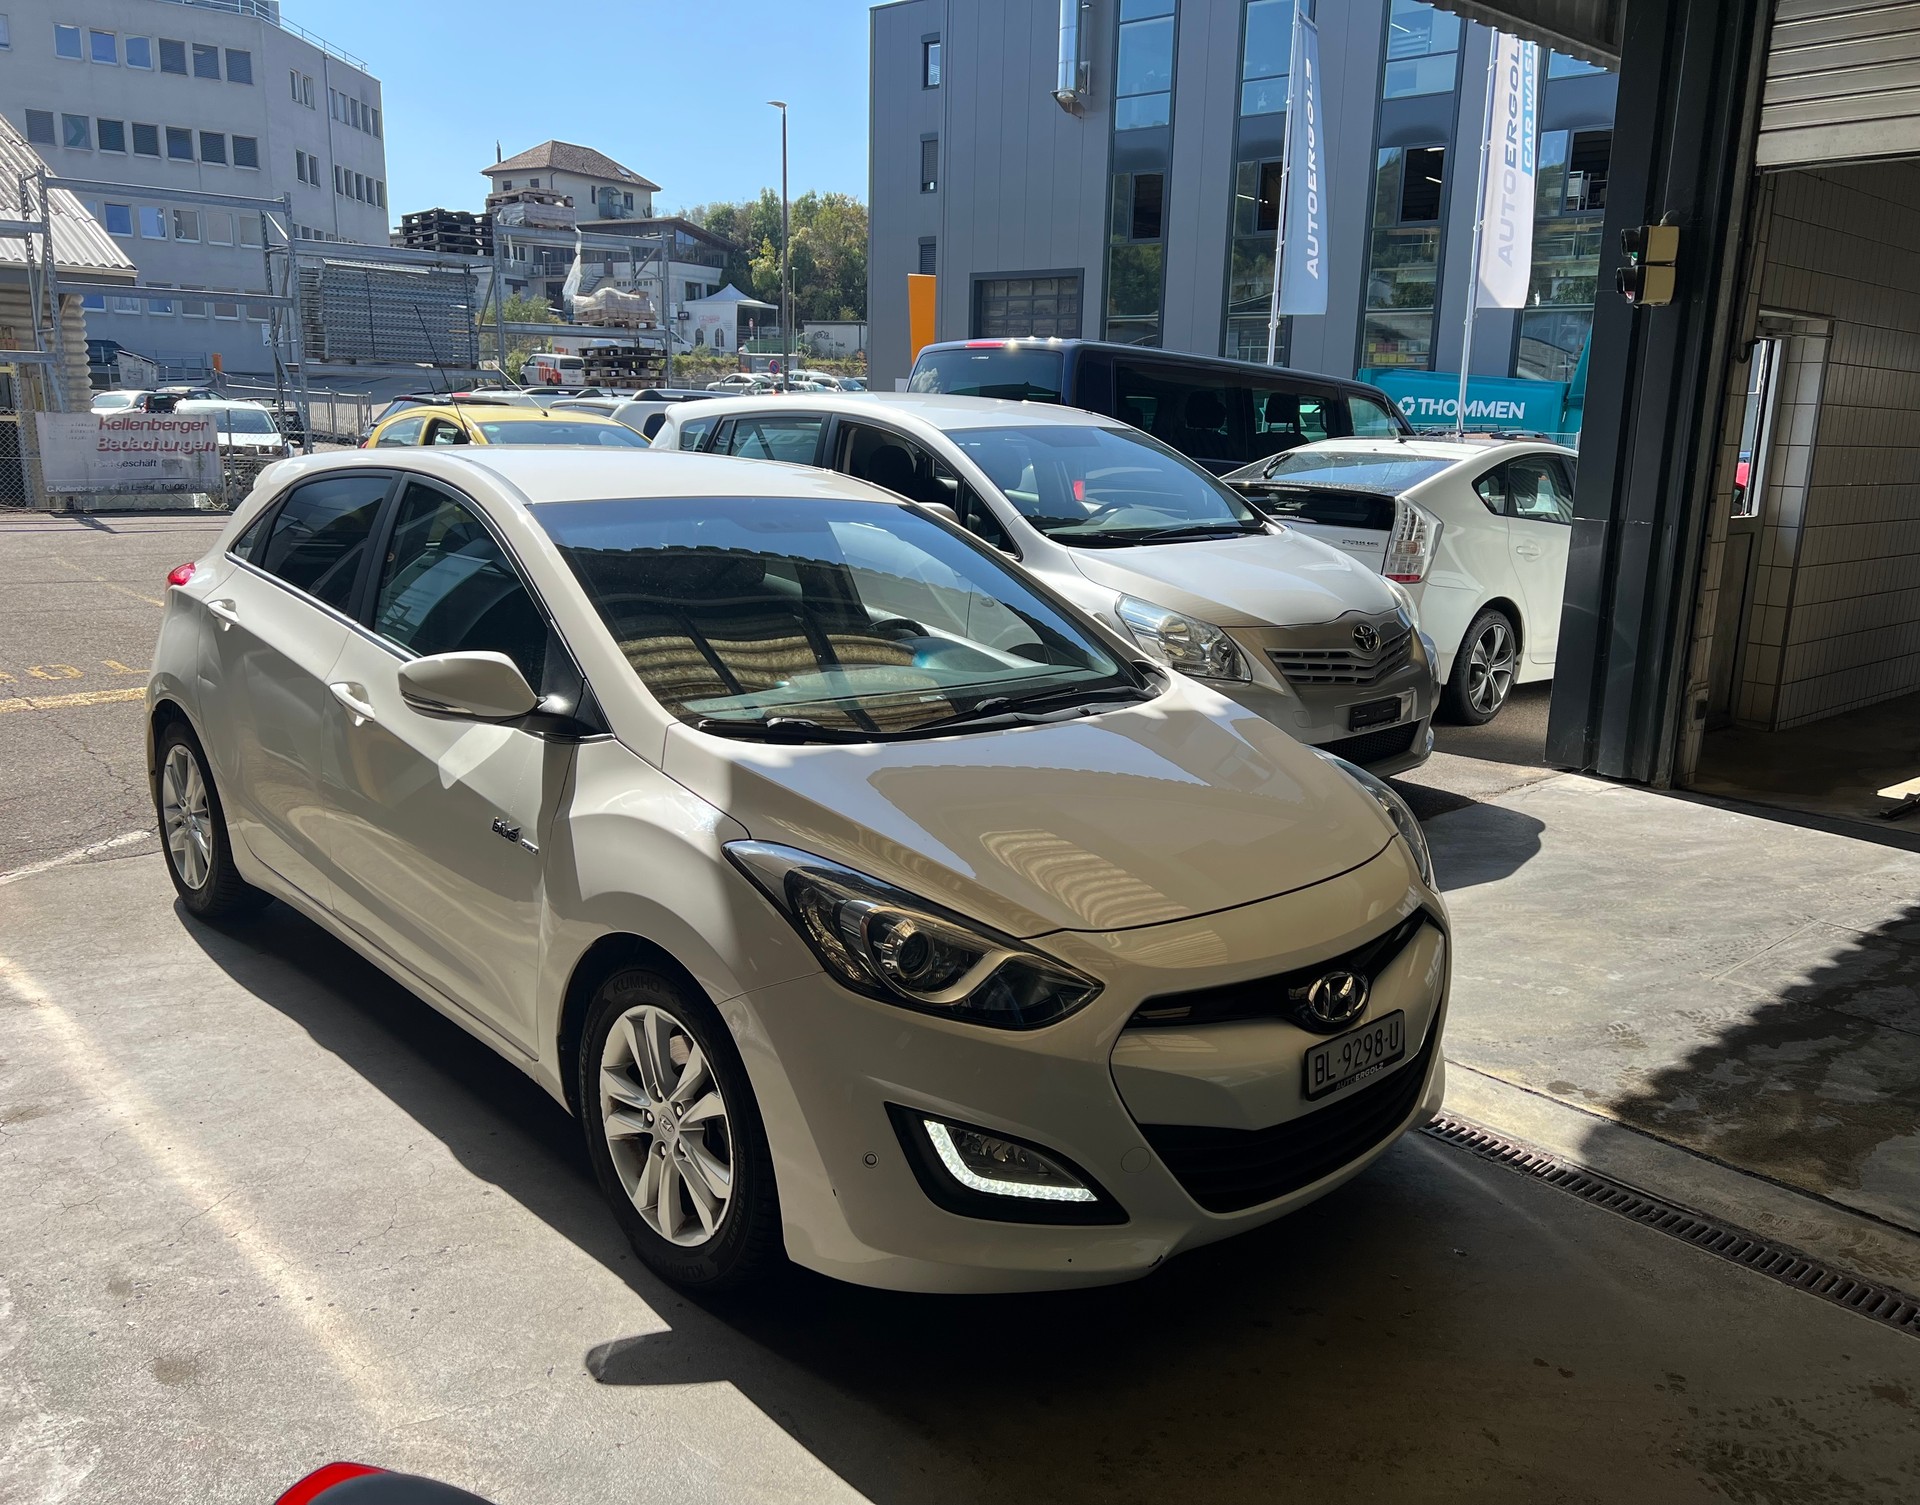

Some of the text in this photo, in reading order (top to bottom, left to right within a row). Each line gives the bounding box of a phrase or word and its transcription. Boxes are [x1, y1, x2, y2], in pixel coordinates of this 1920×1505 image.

[1498, 33, 1521, 267] AUTOERGOL
[1523, 120, 1533, 169] CAR
[1417, 398, 1526, 420] THOMMEN
[98, 417, 209, 434] Kellenberger
[96, 436, 217, 455] Bedachungen
[612, 975, 660, 994] KUMHO
[1336, 1062, 1384, 1091] AUTOERGOLZ
